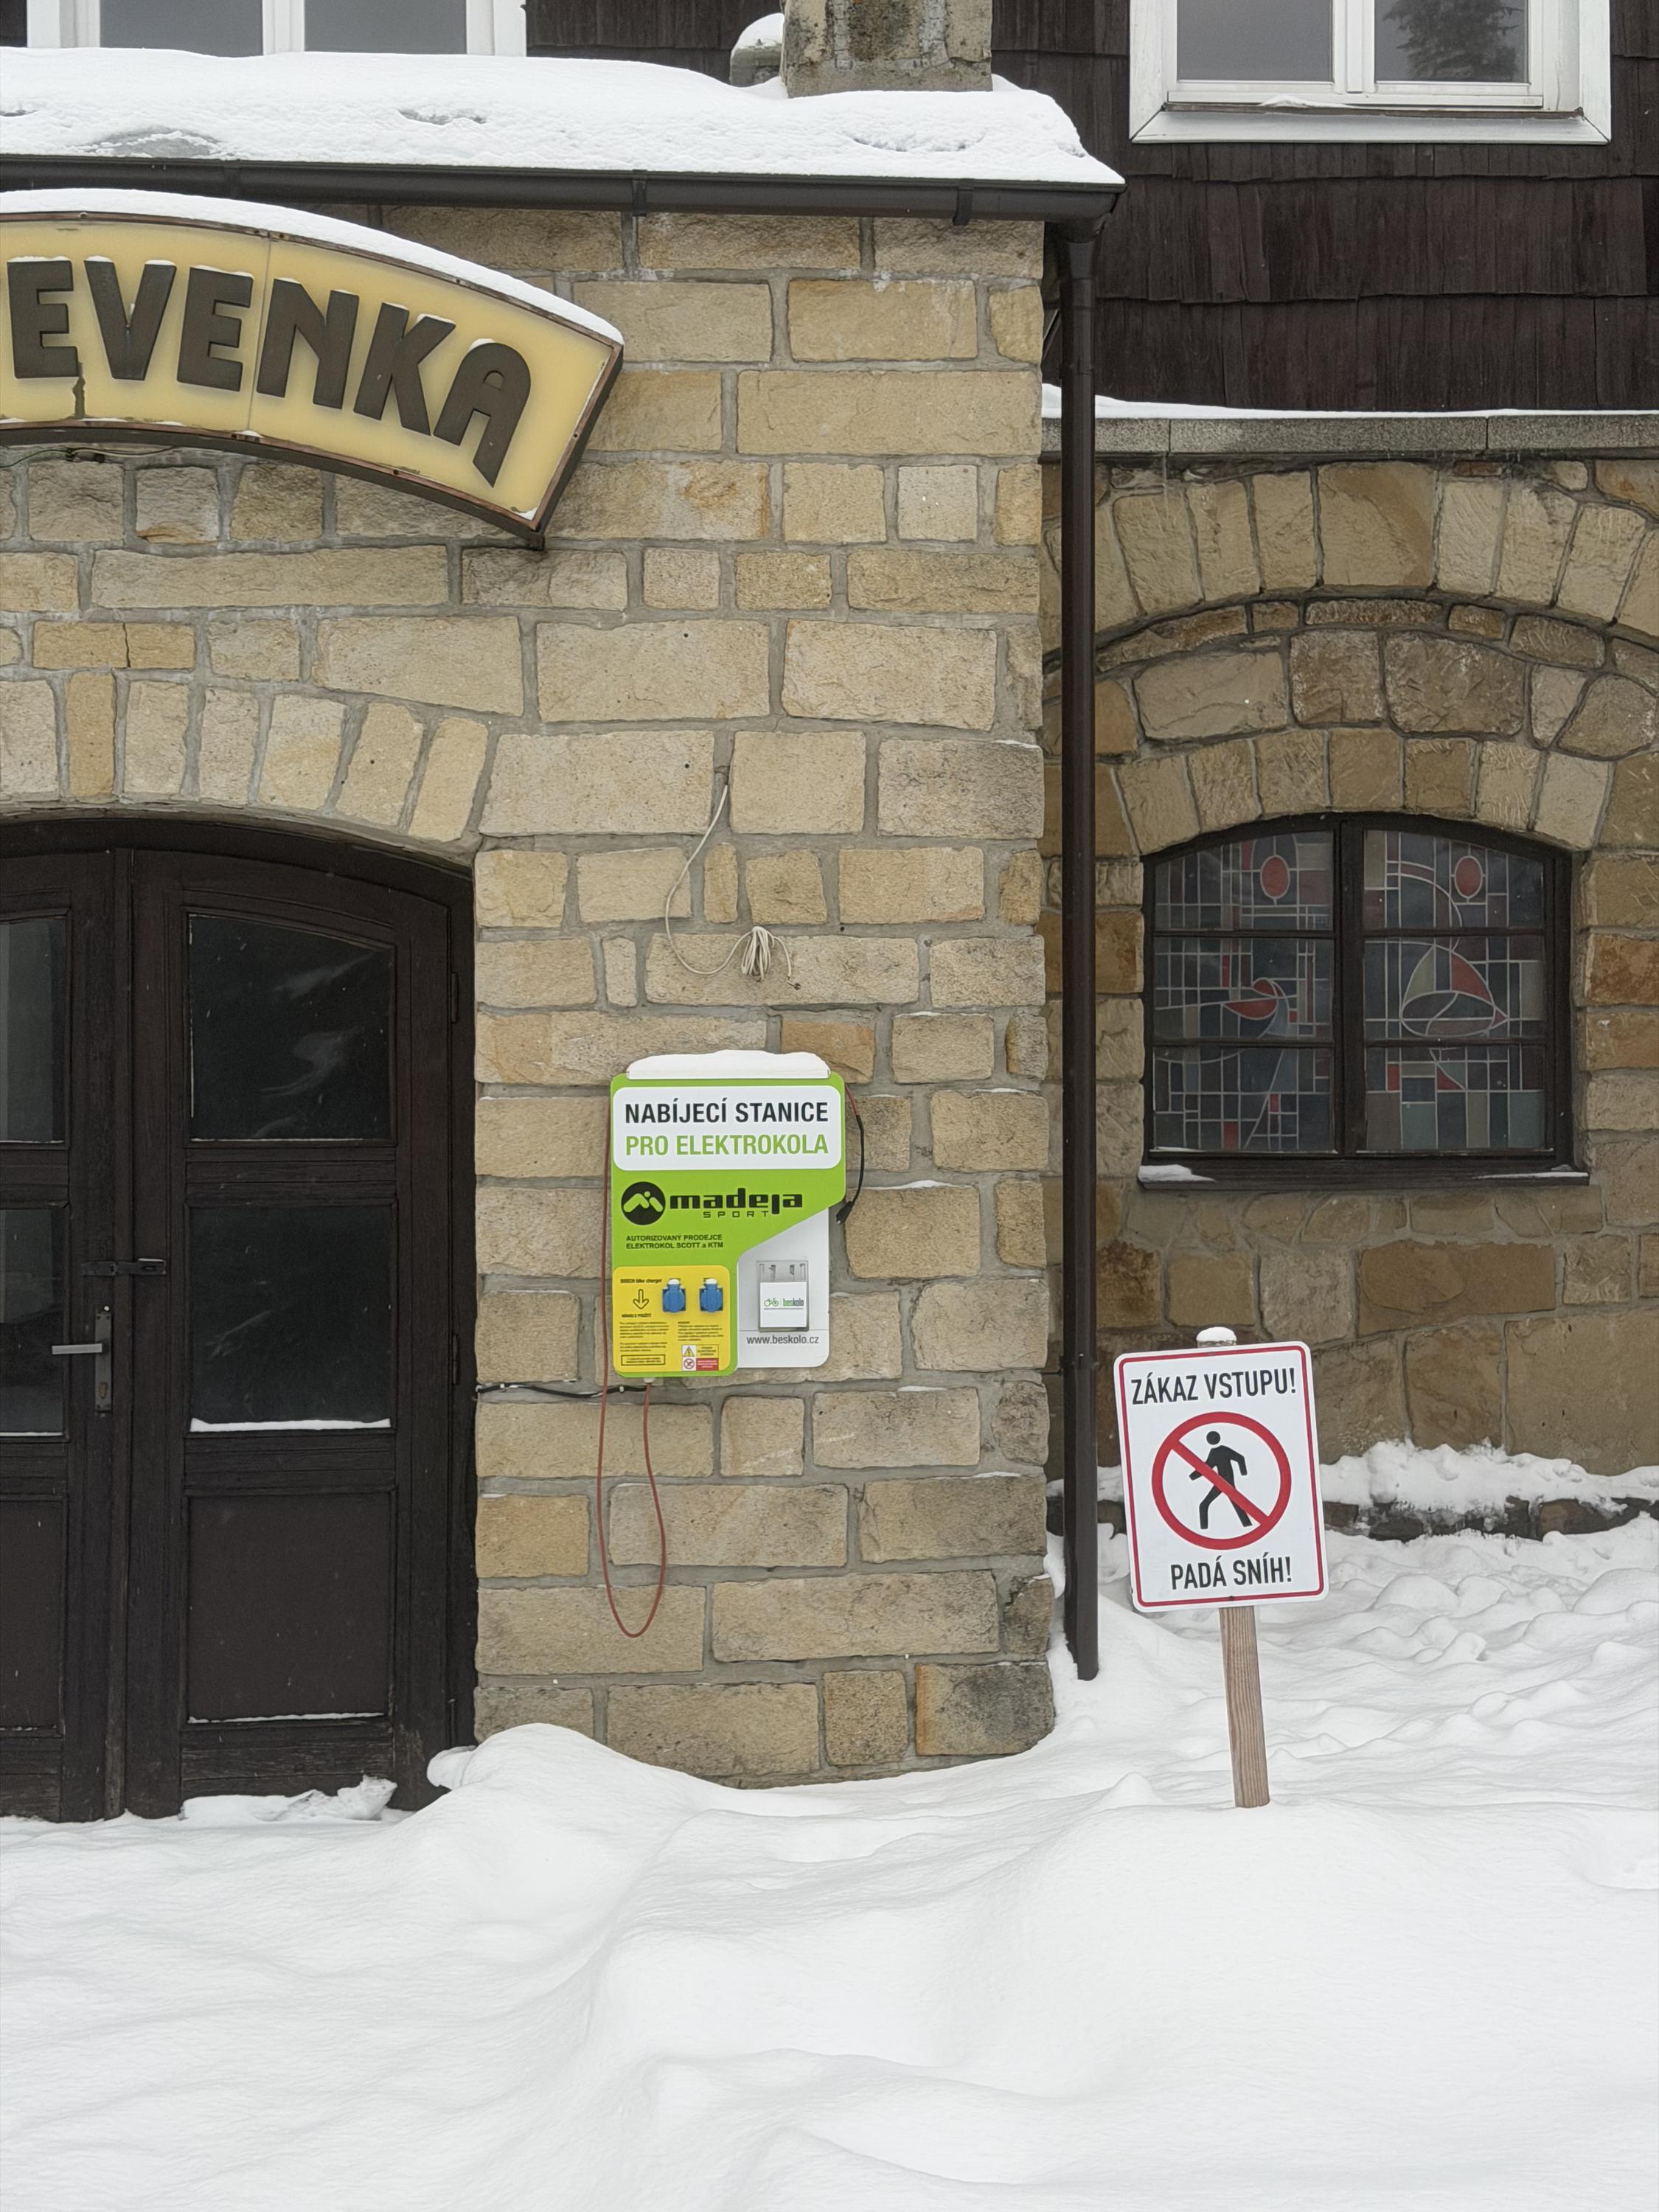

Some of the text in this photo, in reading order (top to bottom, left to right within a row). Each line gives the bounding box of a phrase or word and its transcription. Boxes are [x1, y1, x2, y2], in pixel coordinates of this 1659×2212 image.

[7, 258, 532, 487] EVENKA
[625, 1097, 829, 1123] NABÍJECÍ STANICE
[626, 1134, 829, 1155] PRO ELEKTROKOLA
[669, 1188, 803, 1214] madeja
[626, 1234, 681, 1242] AUTORIZOVANÝ
[746, 1335, 819, 1344] www.beskolo.cz
[1130, 1368, 1297, 1405] ZÁKAZ VSTUPU!
[1170, 1552, 1293, 1590] PADÁ SNÍH!
